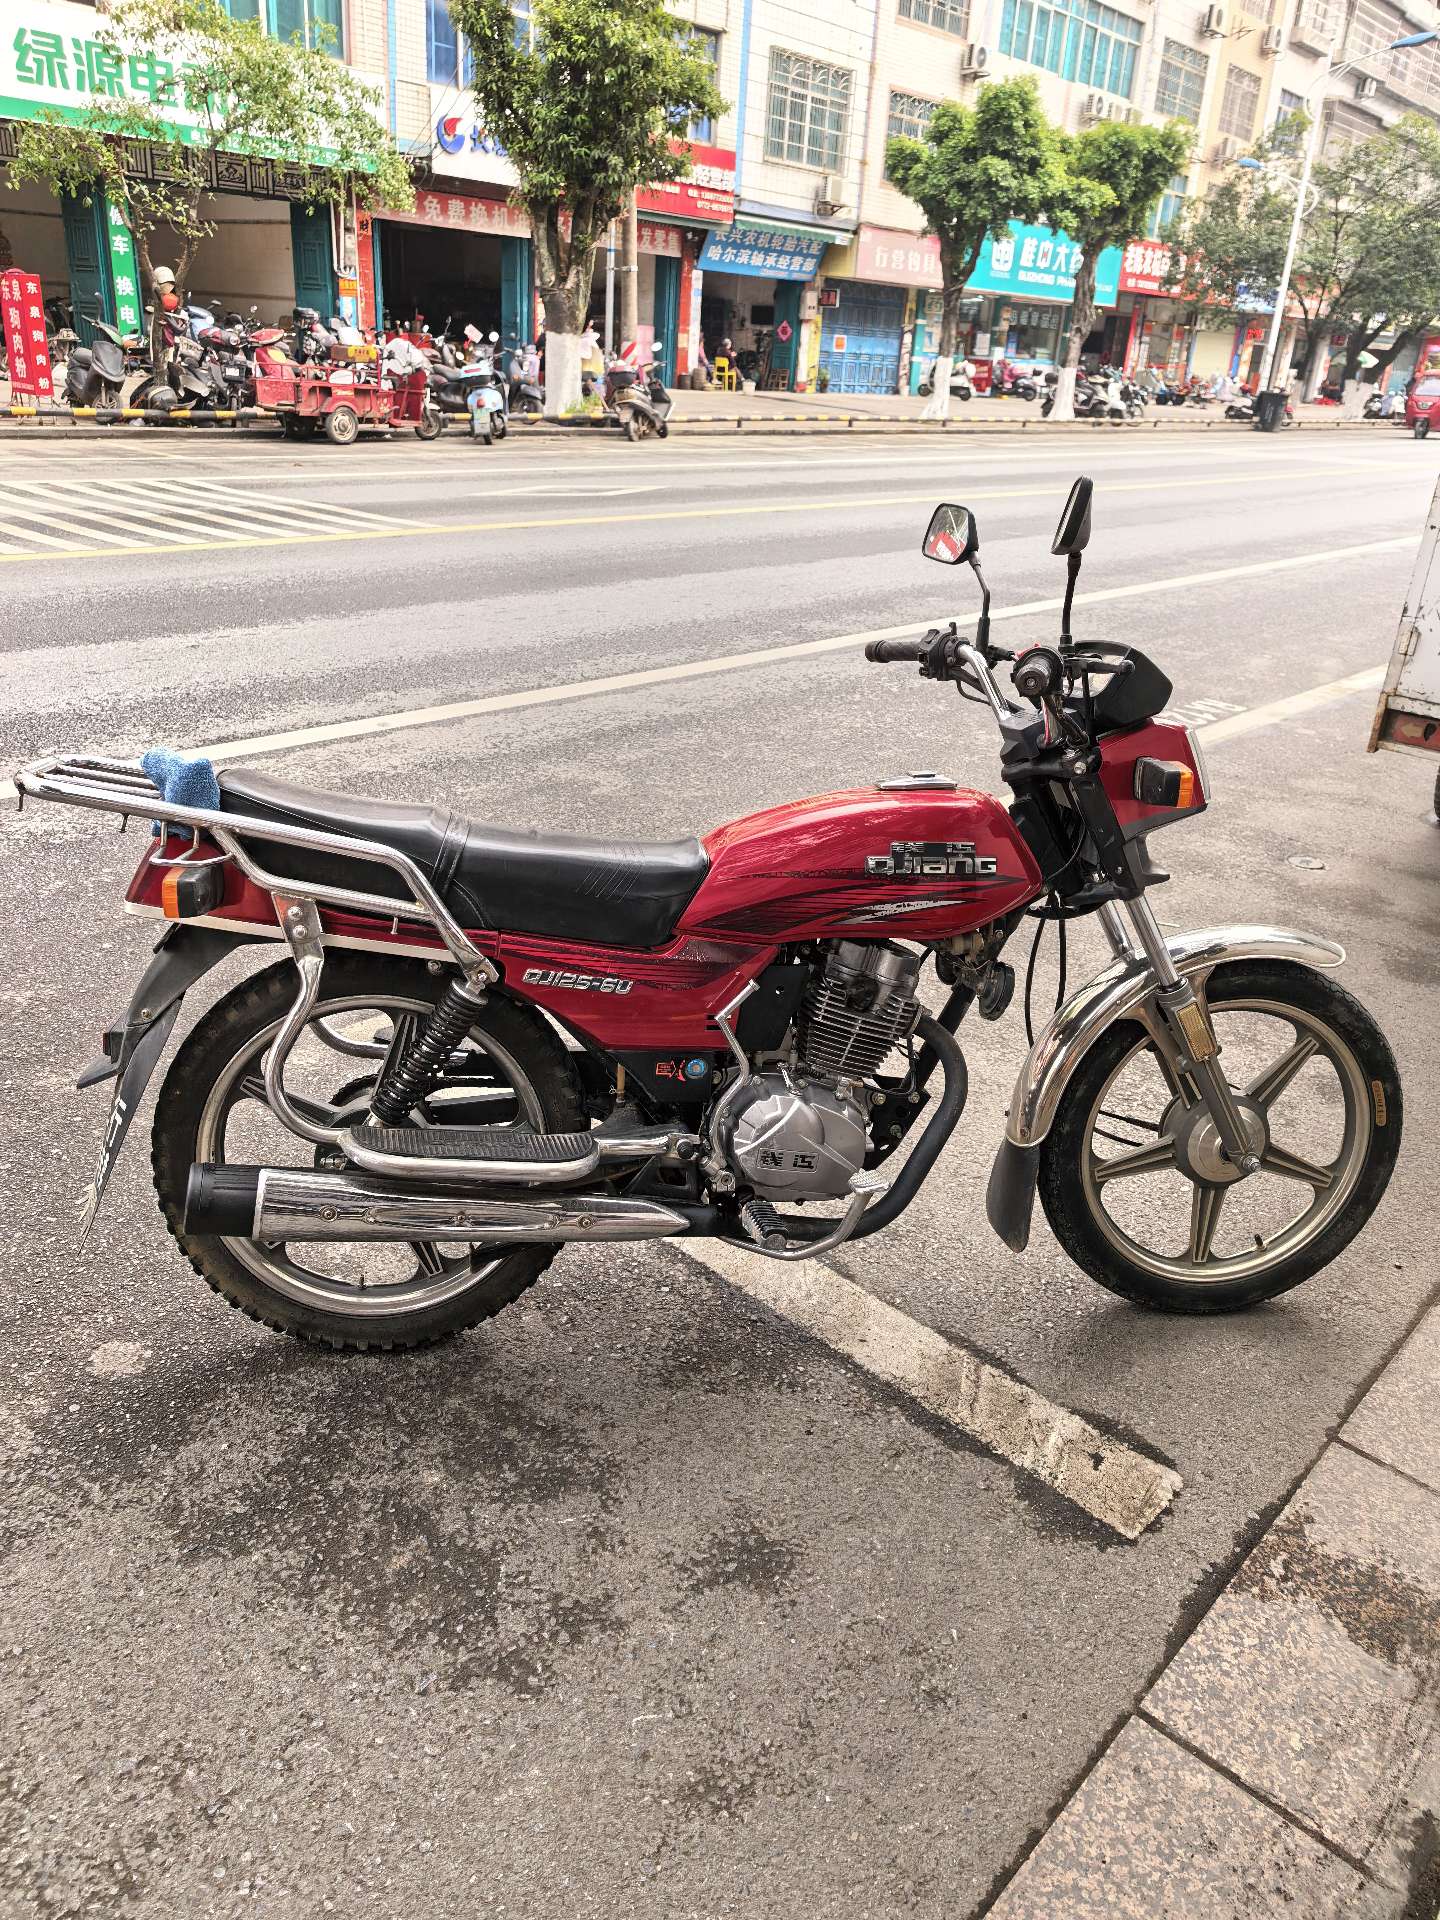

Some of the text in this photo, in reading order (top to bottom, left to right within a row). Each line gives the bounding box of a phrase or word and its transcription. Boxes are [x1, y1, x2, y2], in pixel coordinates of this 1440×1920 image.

[707, 245, 817, 272] 哈尔滨轴承经营部
[25, 282, 50, 390] 东泉狗肉粉
